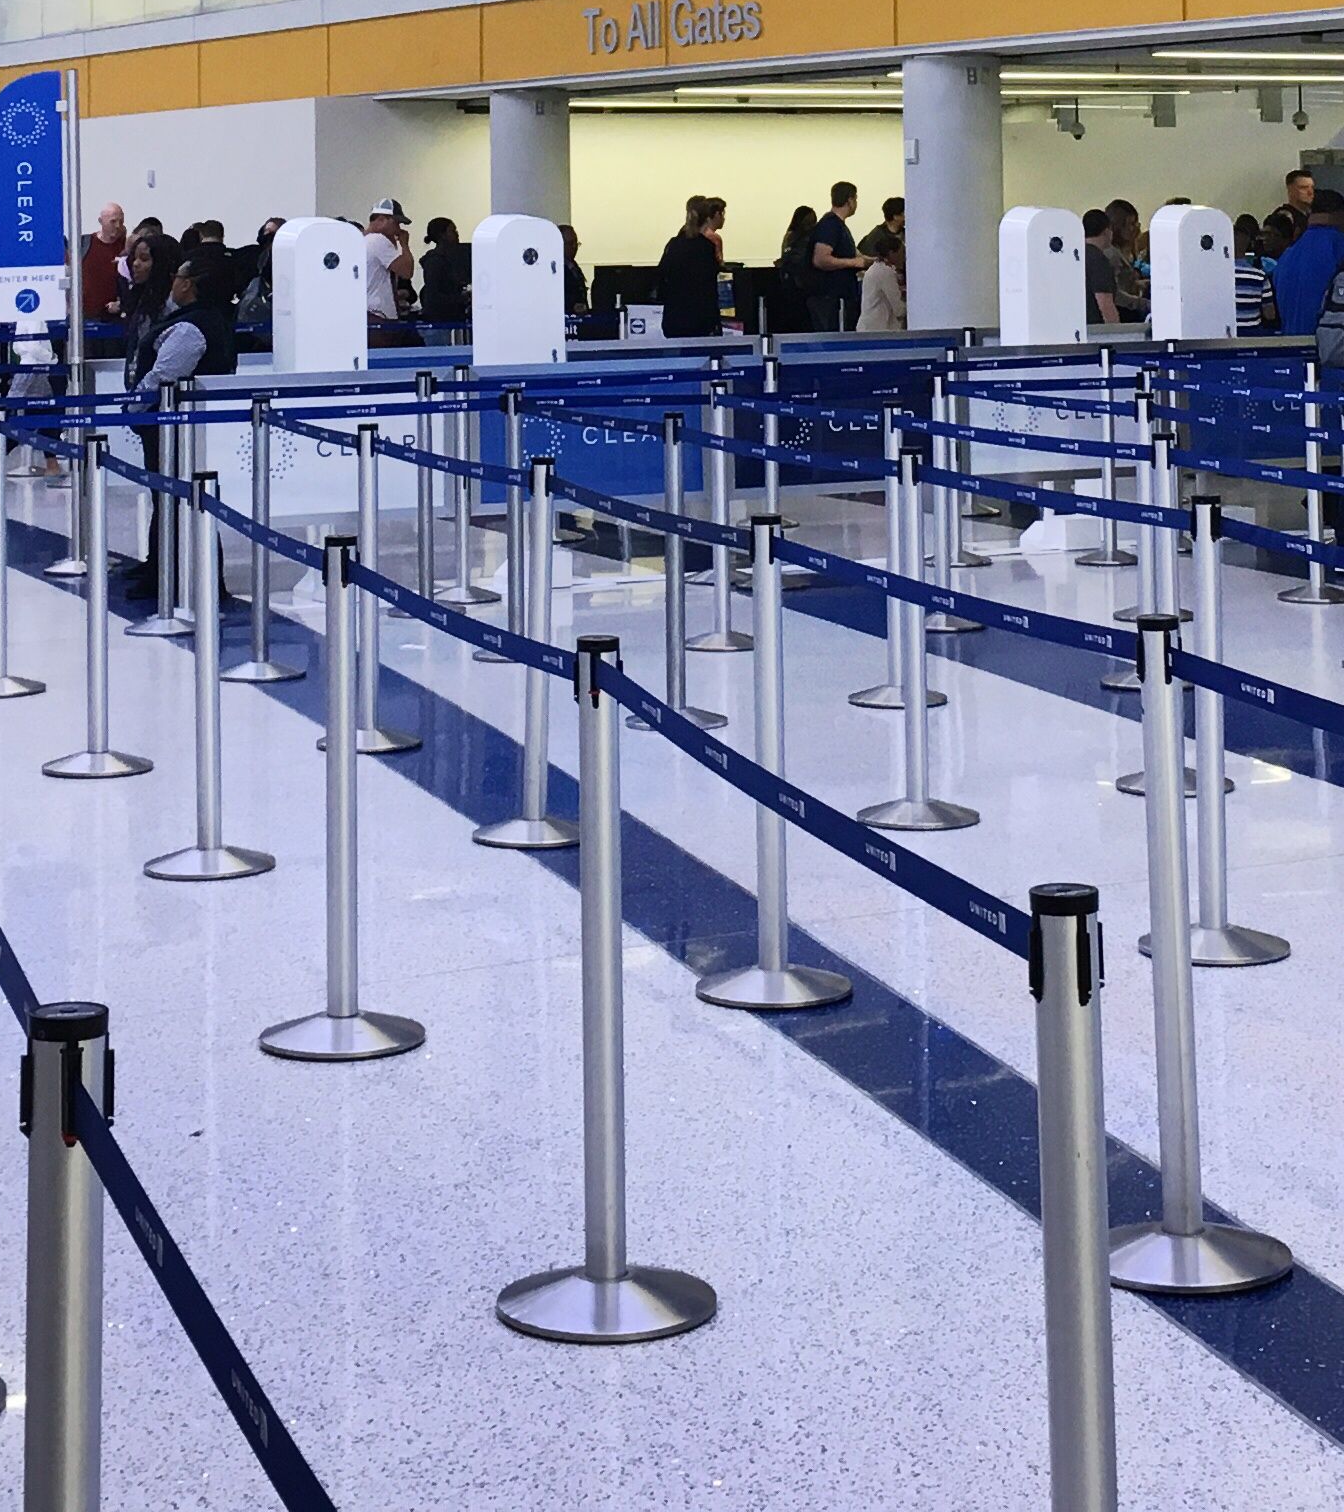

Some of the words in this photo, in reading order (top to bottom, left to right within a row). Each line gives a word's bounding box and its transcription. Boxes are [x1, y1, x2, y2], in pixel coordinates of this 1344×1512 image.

[582, 7, 619, 55] To
[626, 0, 662, 52] All
[16, 161, 34, 242] CLEAR
[31, 273, 56, 282] HERE
[1241, 683, 1266, 698] UNITED
[969, 901, 997, 925] UNITED
